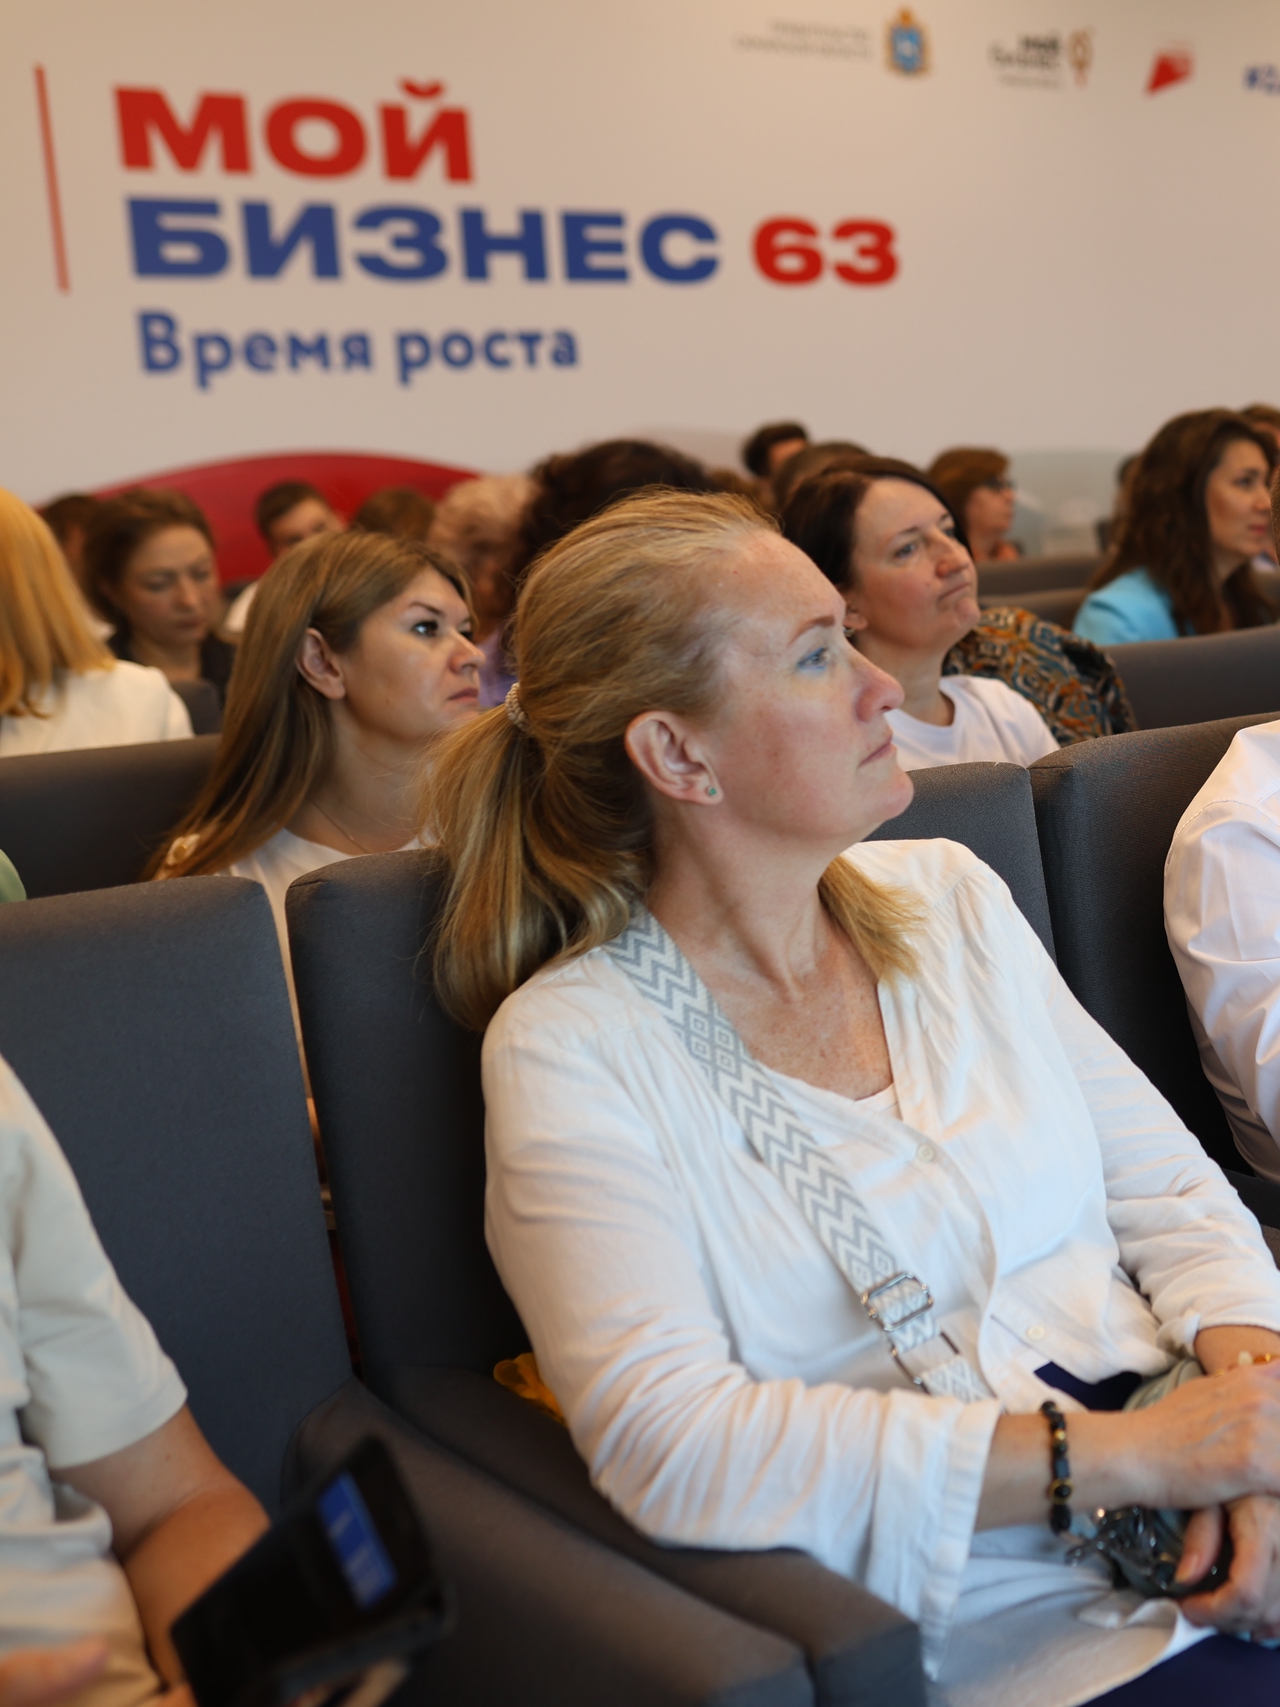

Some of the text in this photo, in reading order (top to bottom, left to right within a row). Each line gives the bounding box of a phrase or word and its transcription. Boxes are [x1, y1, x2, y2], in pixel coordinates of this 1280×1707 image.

[114, 79, 475, 183] МОЙ
[126, 195, 900, 288] БИЗНЕС 63
[136, 309, 580, 391] Время роста
